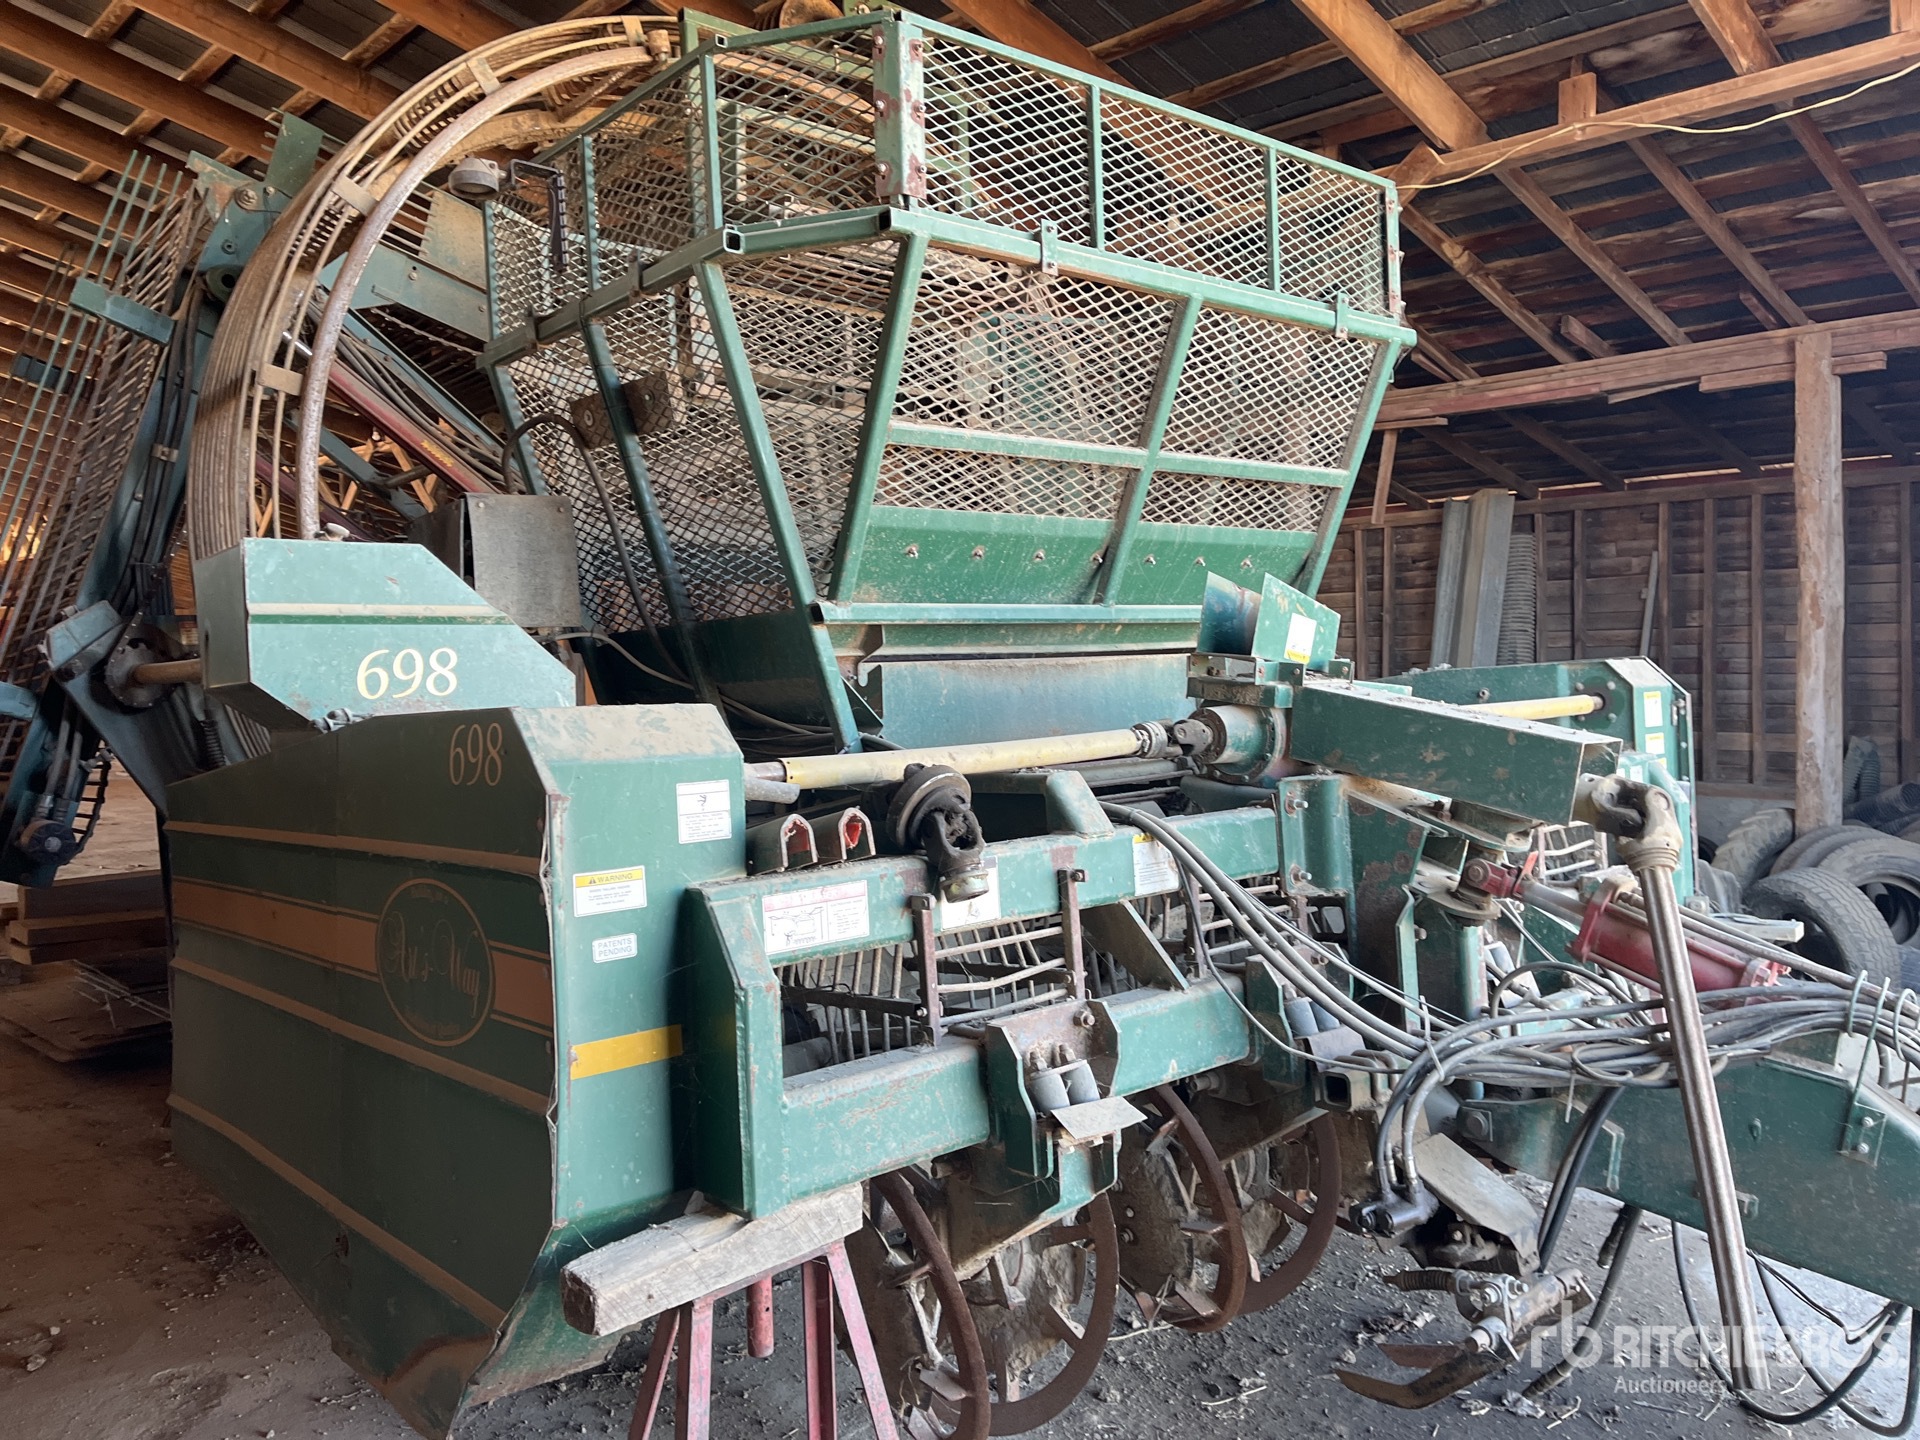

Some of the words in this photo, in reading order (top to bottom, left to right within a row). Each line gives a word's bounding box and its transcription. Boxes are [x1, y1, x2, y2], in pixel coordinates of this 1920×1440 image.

[356, 648, 458, 699] 698
[450, 722, 502, 786] 698
[597, 872, 633, 883] WARNING
[597, 937, 633, 949] PATENTS
[598, 945, 633, 957] PENDING
